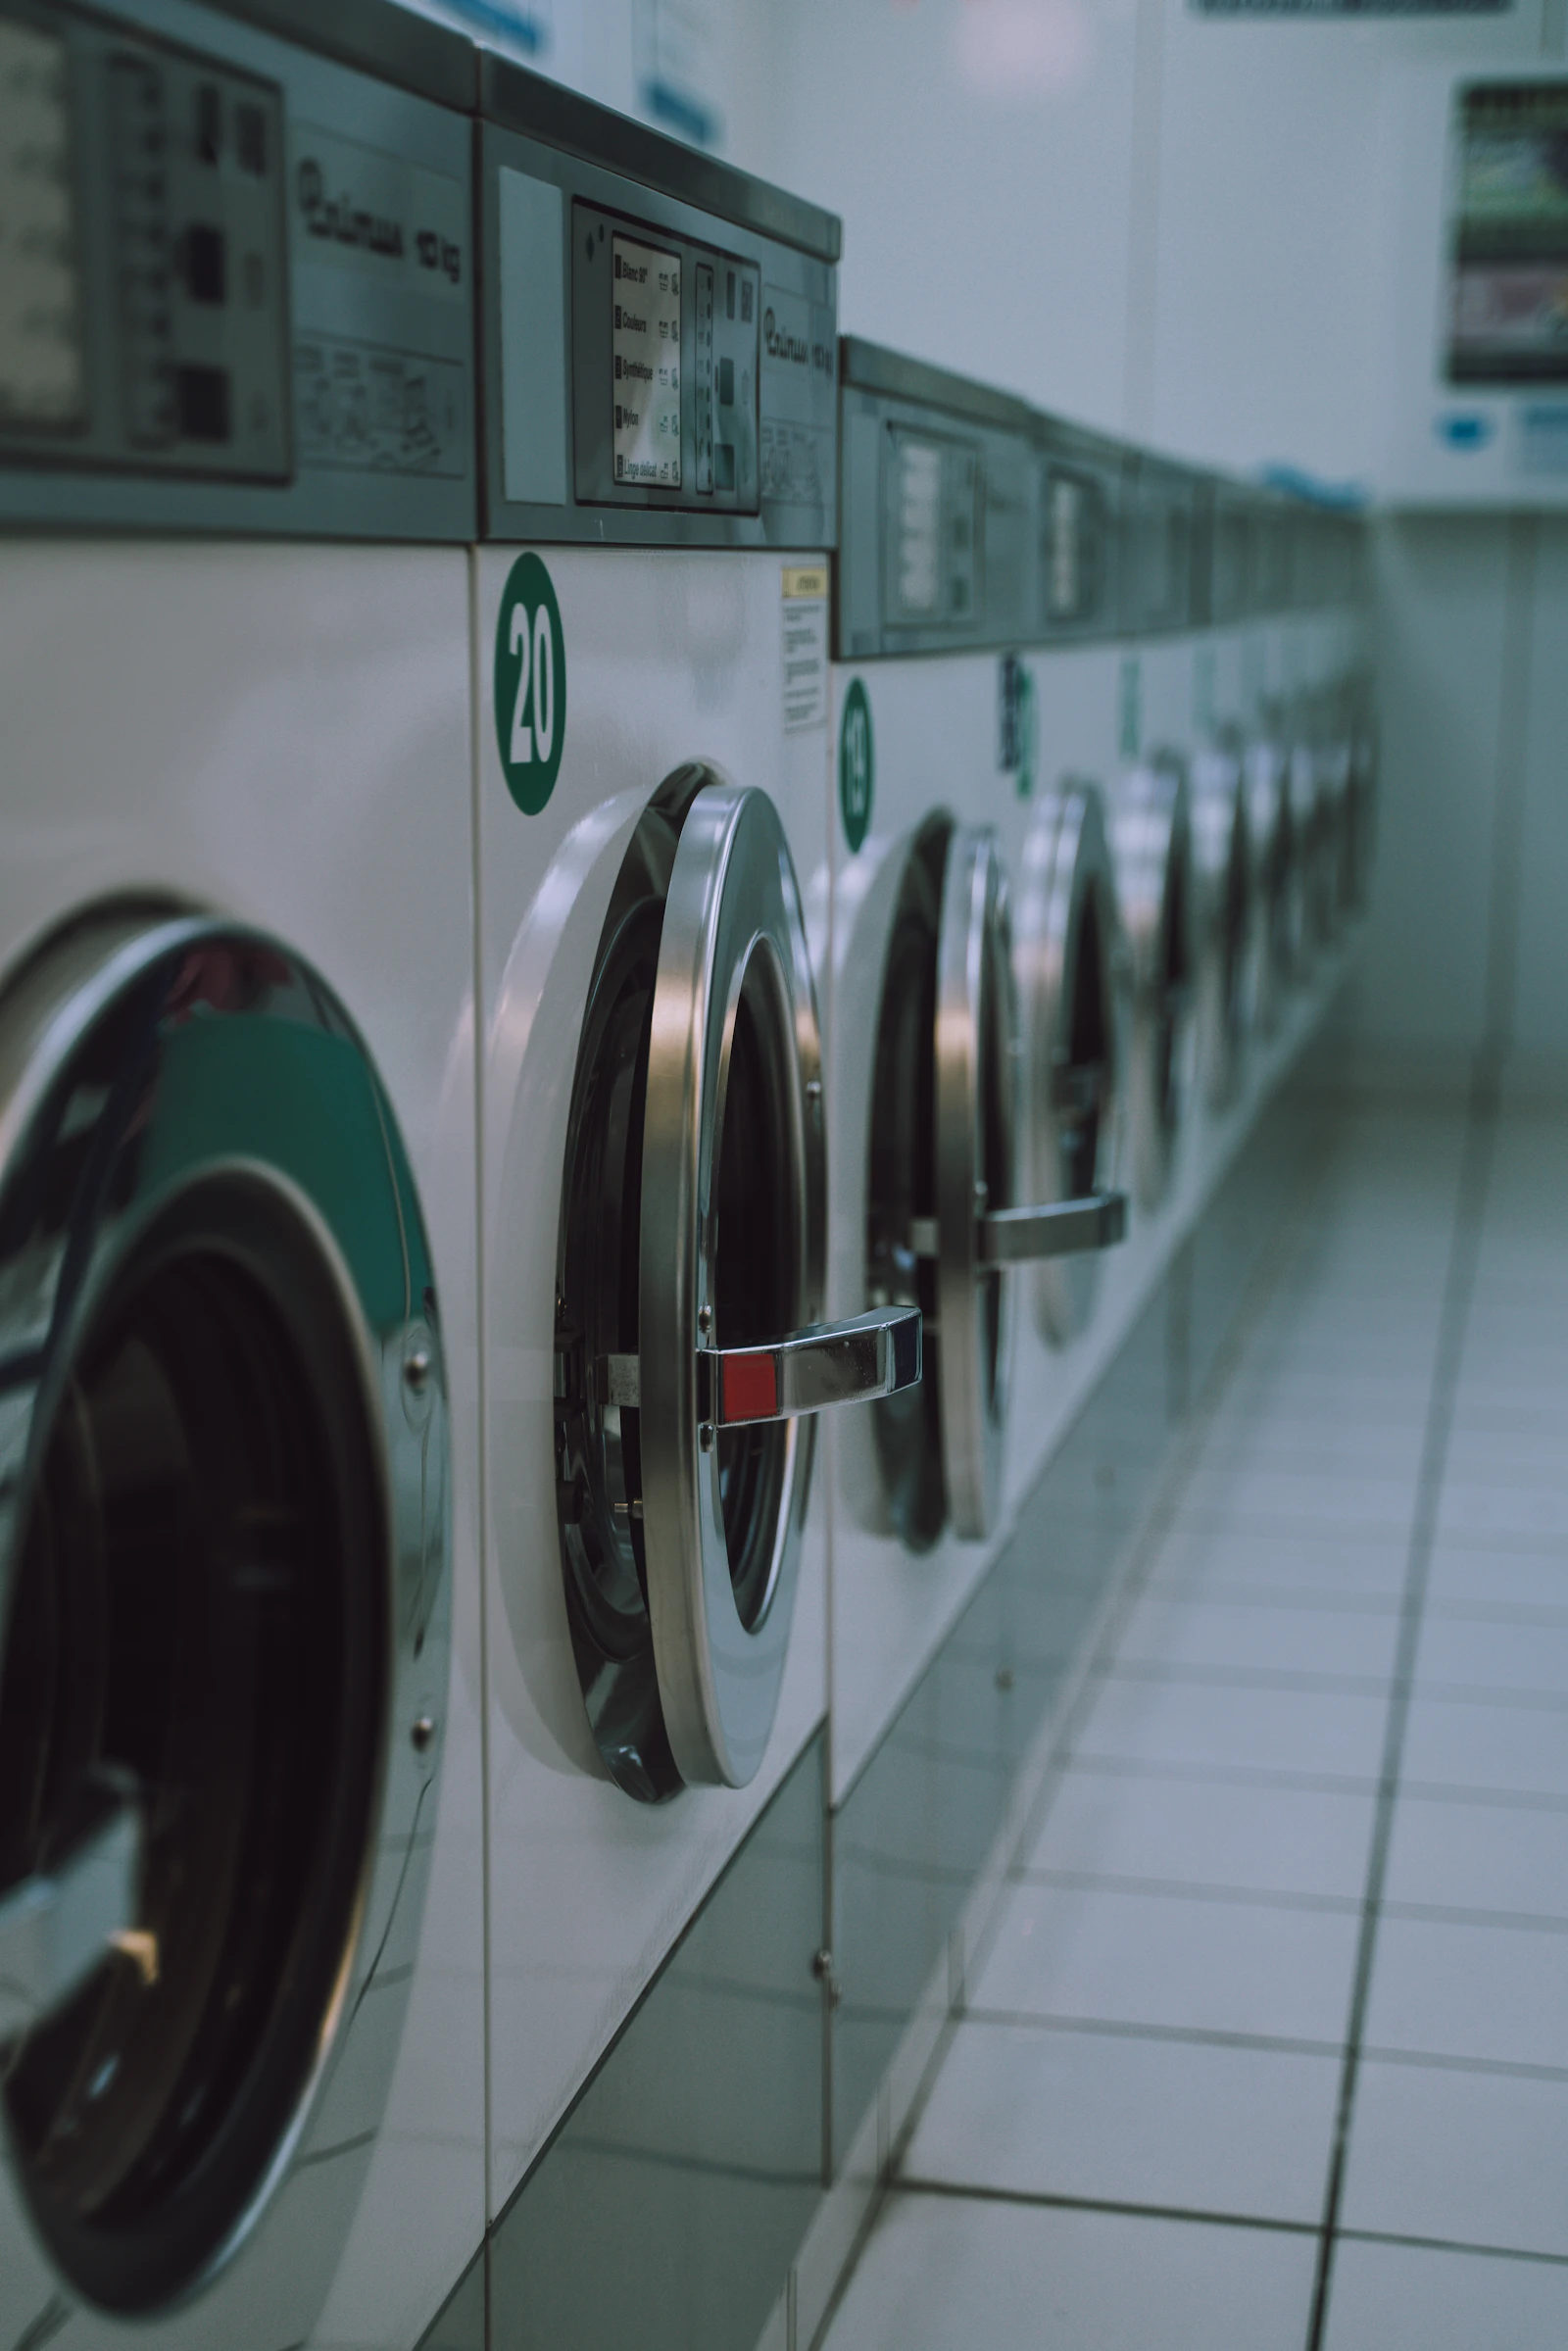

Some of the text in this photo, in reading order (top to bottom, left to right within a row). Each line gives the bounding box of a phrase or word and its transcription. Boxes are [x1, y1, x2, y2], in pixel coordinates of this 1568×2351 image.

[623, 262, 638, 282] Blanc
[623, 312, 647, 333] Couleurs
[623, 408, 639, 429] Nylon
[624, 459, 639, 479] Linge
[509, 603, 555, 764] 20
